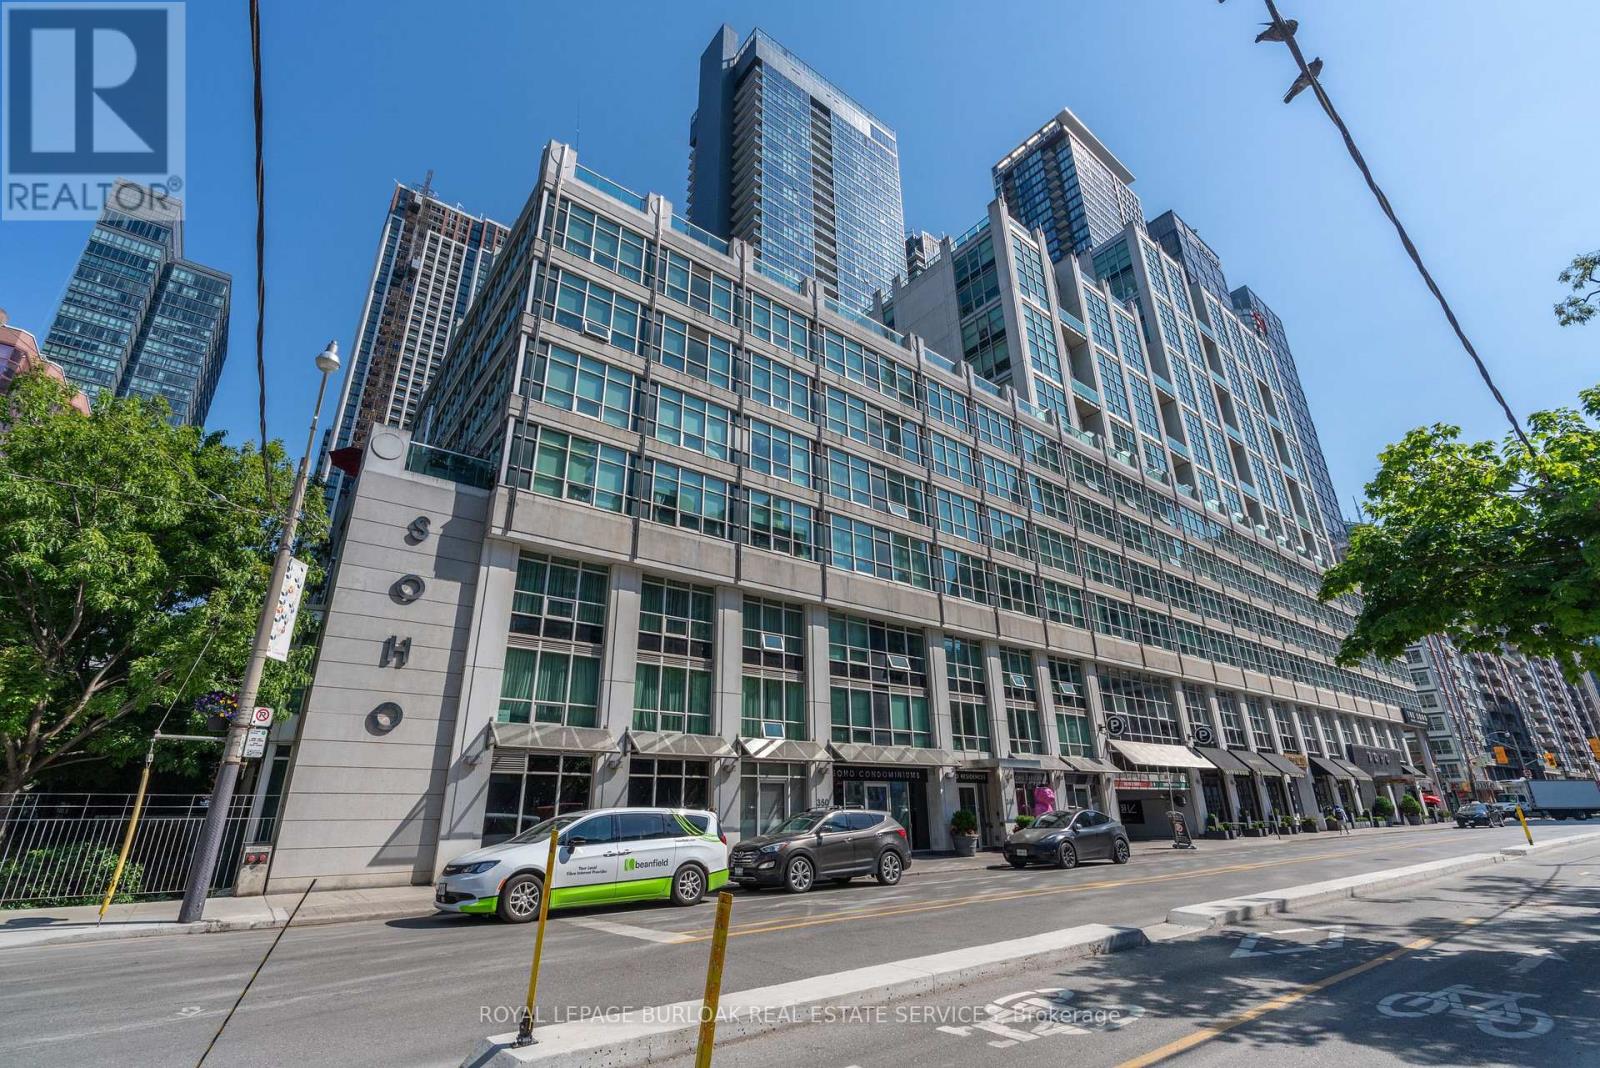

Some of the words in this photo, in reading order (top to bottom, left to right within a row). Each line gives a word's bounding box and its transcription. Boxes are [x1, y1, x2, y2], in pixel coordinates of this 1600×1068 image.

[375, 515, 431, 733] SOHO
[858, 769, 920, 779] CONDOMINIUMS
[816, 798, 830, 807] 350
[635, 858, 669, 869] beanfield
